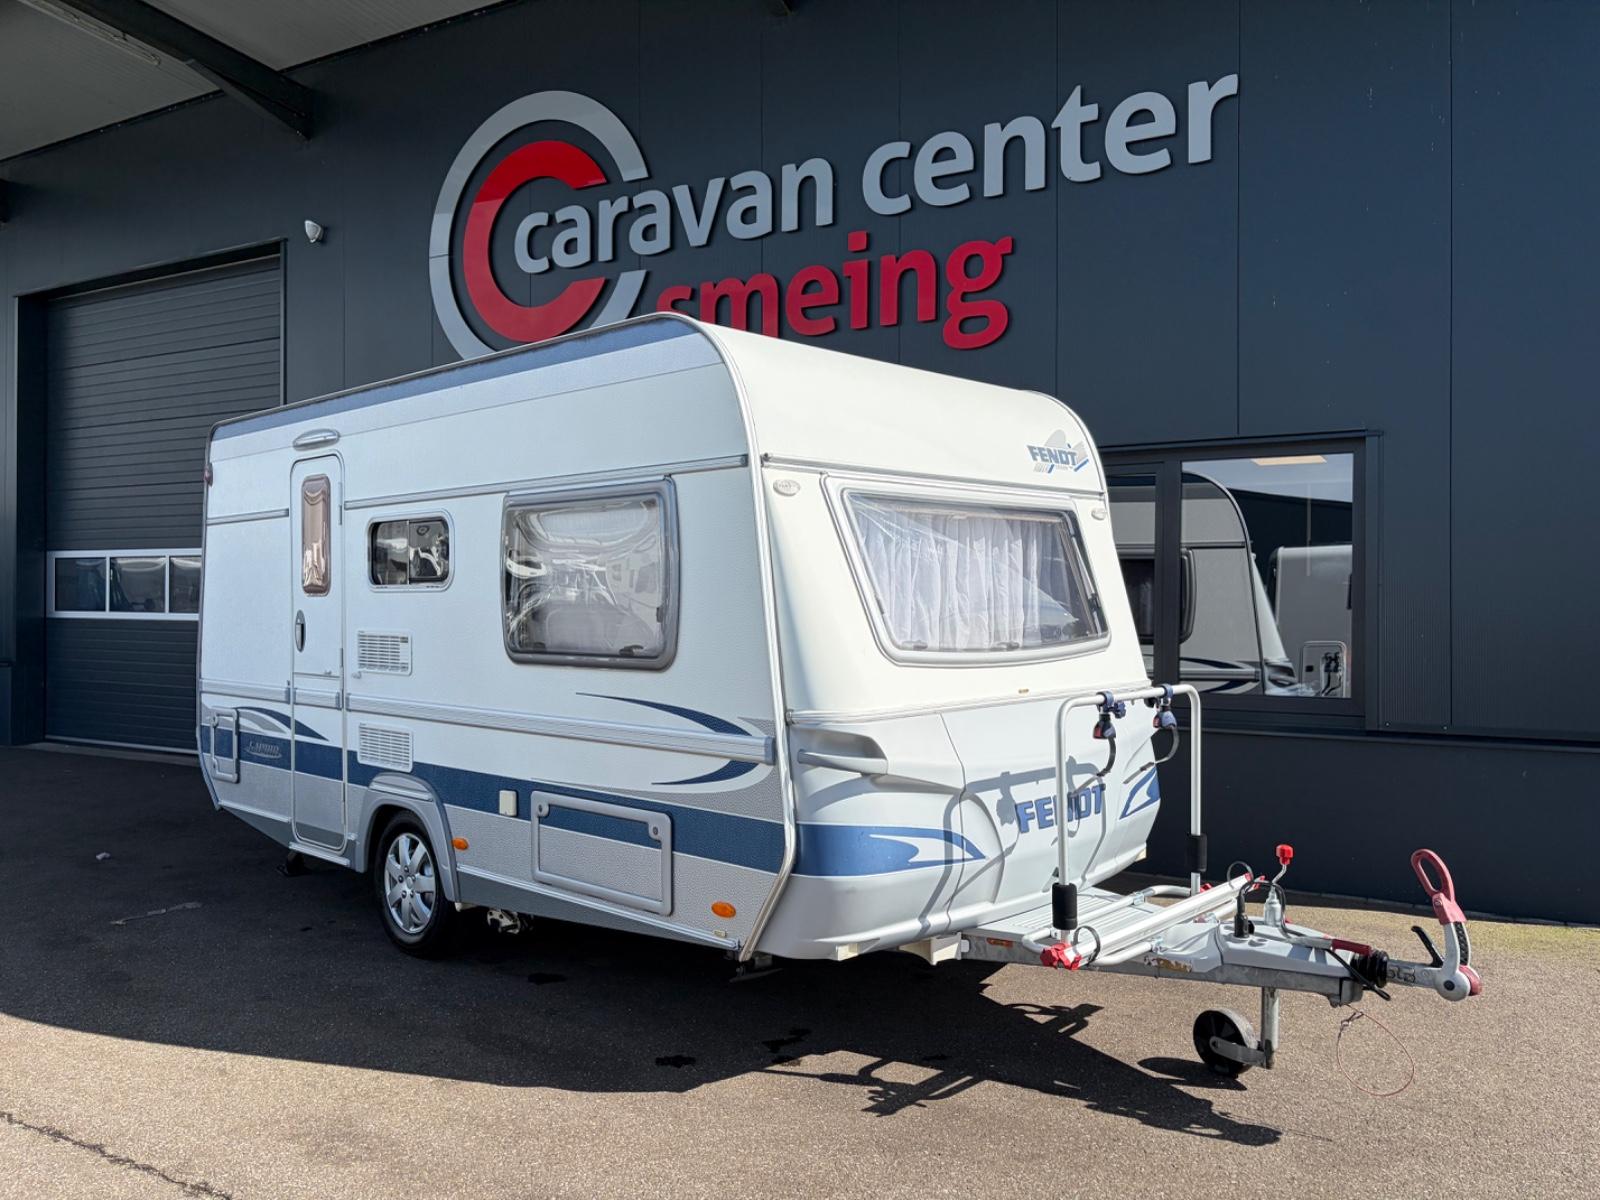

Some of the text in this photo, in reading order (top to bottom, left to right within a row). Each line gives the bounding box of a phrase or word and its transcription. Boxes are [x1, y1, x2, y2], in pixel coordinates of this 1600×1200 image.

[514, 73, 1239, 274] caravan center
[1026, 444, 1077, 466] FENDT
